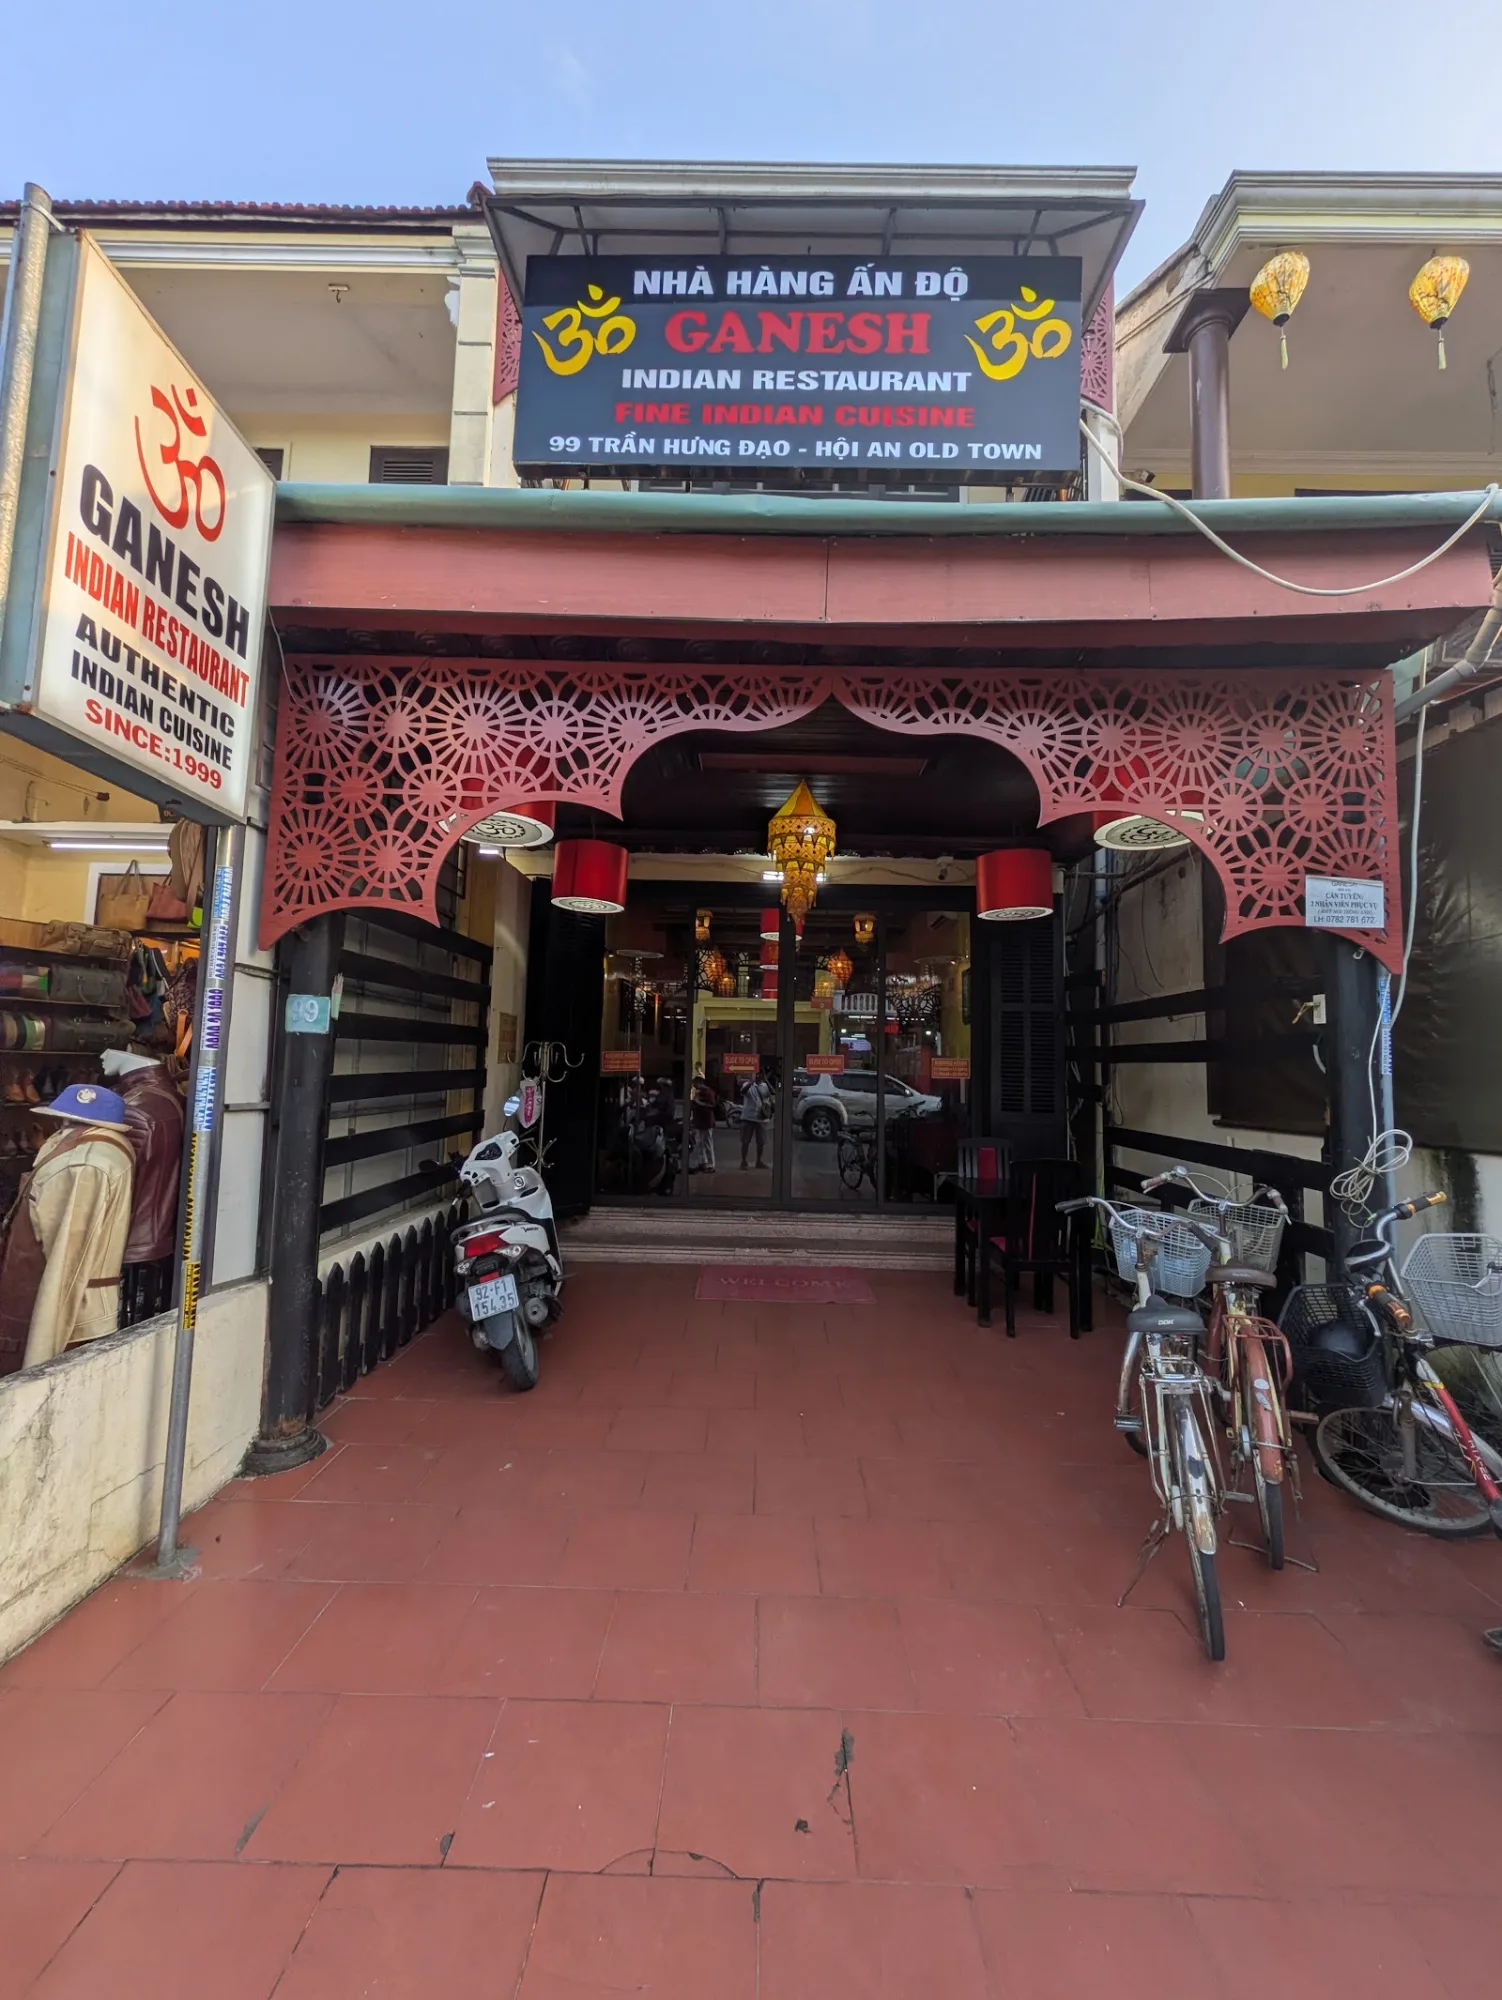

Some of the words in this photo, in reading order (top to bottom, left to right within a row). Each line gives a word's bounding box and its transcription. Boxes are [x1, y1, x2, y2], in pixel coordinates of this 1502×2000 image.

[633, 265, 713, 295] NHÀ
[727, 266, 834, 296] HÀNG
[847, 262, 902, 296] ẤN
[915, 266, 969, 302] ĐỘ
[665, 310, 931, 355] GANESH
[622, 369, 740, 391] INDIAN
[753, 369, 972, 393] RESTAURANT
[615, 402, 690, 425] FINE
[702, 403, 823, 426] INDIAN
[834, 404, 976, 428] CUISINE
[549, 435, 581, 453] 99
[589, 431, 655, 454] TRẦN
[664, 435, 731, 457] HƯNG
[738, 439, 790, 460] ĐẠO
[815, 436, 859, 462] HỘI
[866, 441, 900, 459] AN
[908, 442, 959, 460] OLD
[968, 442, 1042, 461] TOWN
[79, 463, 251, 661] GANESH
[64, 530, 141, 631] INDIAN
[141, 595, 250, 709] RESTAURANT
[74, 612, 236, 739] AUTHENTIC
[71, 648, 154, 725] INDIAN
[159, 705, 234, 772] CUISINE
[84, 697, 223, 791] SINCE:1999
[292, 999, 319, 1023] 99
[474, 1292, 515, 1317] 154.35
[476, 1279, 508, 1301] 92-F1
